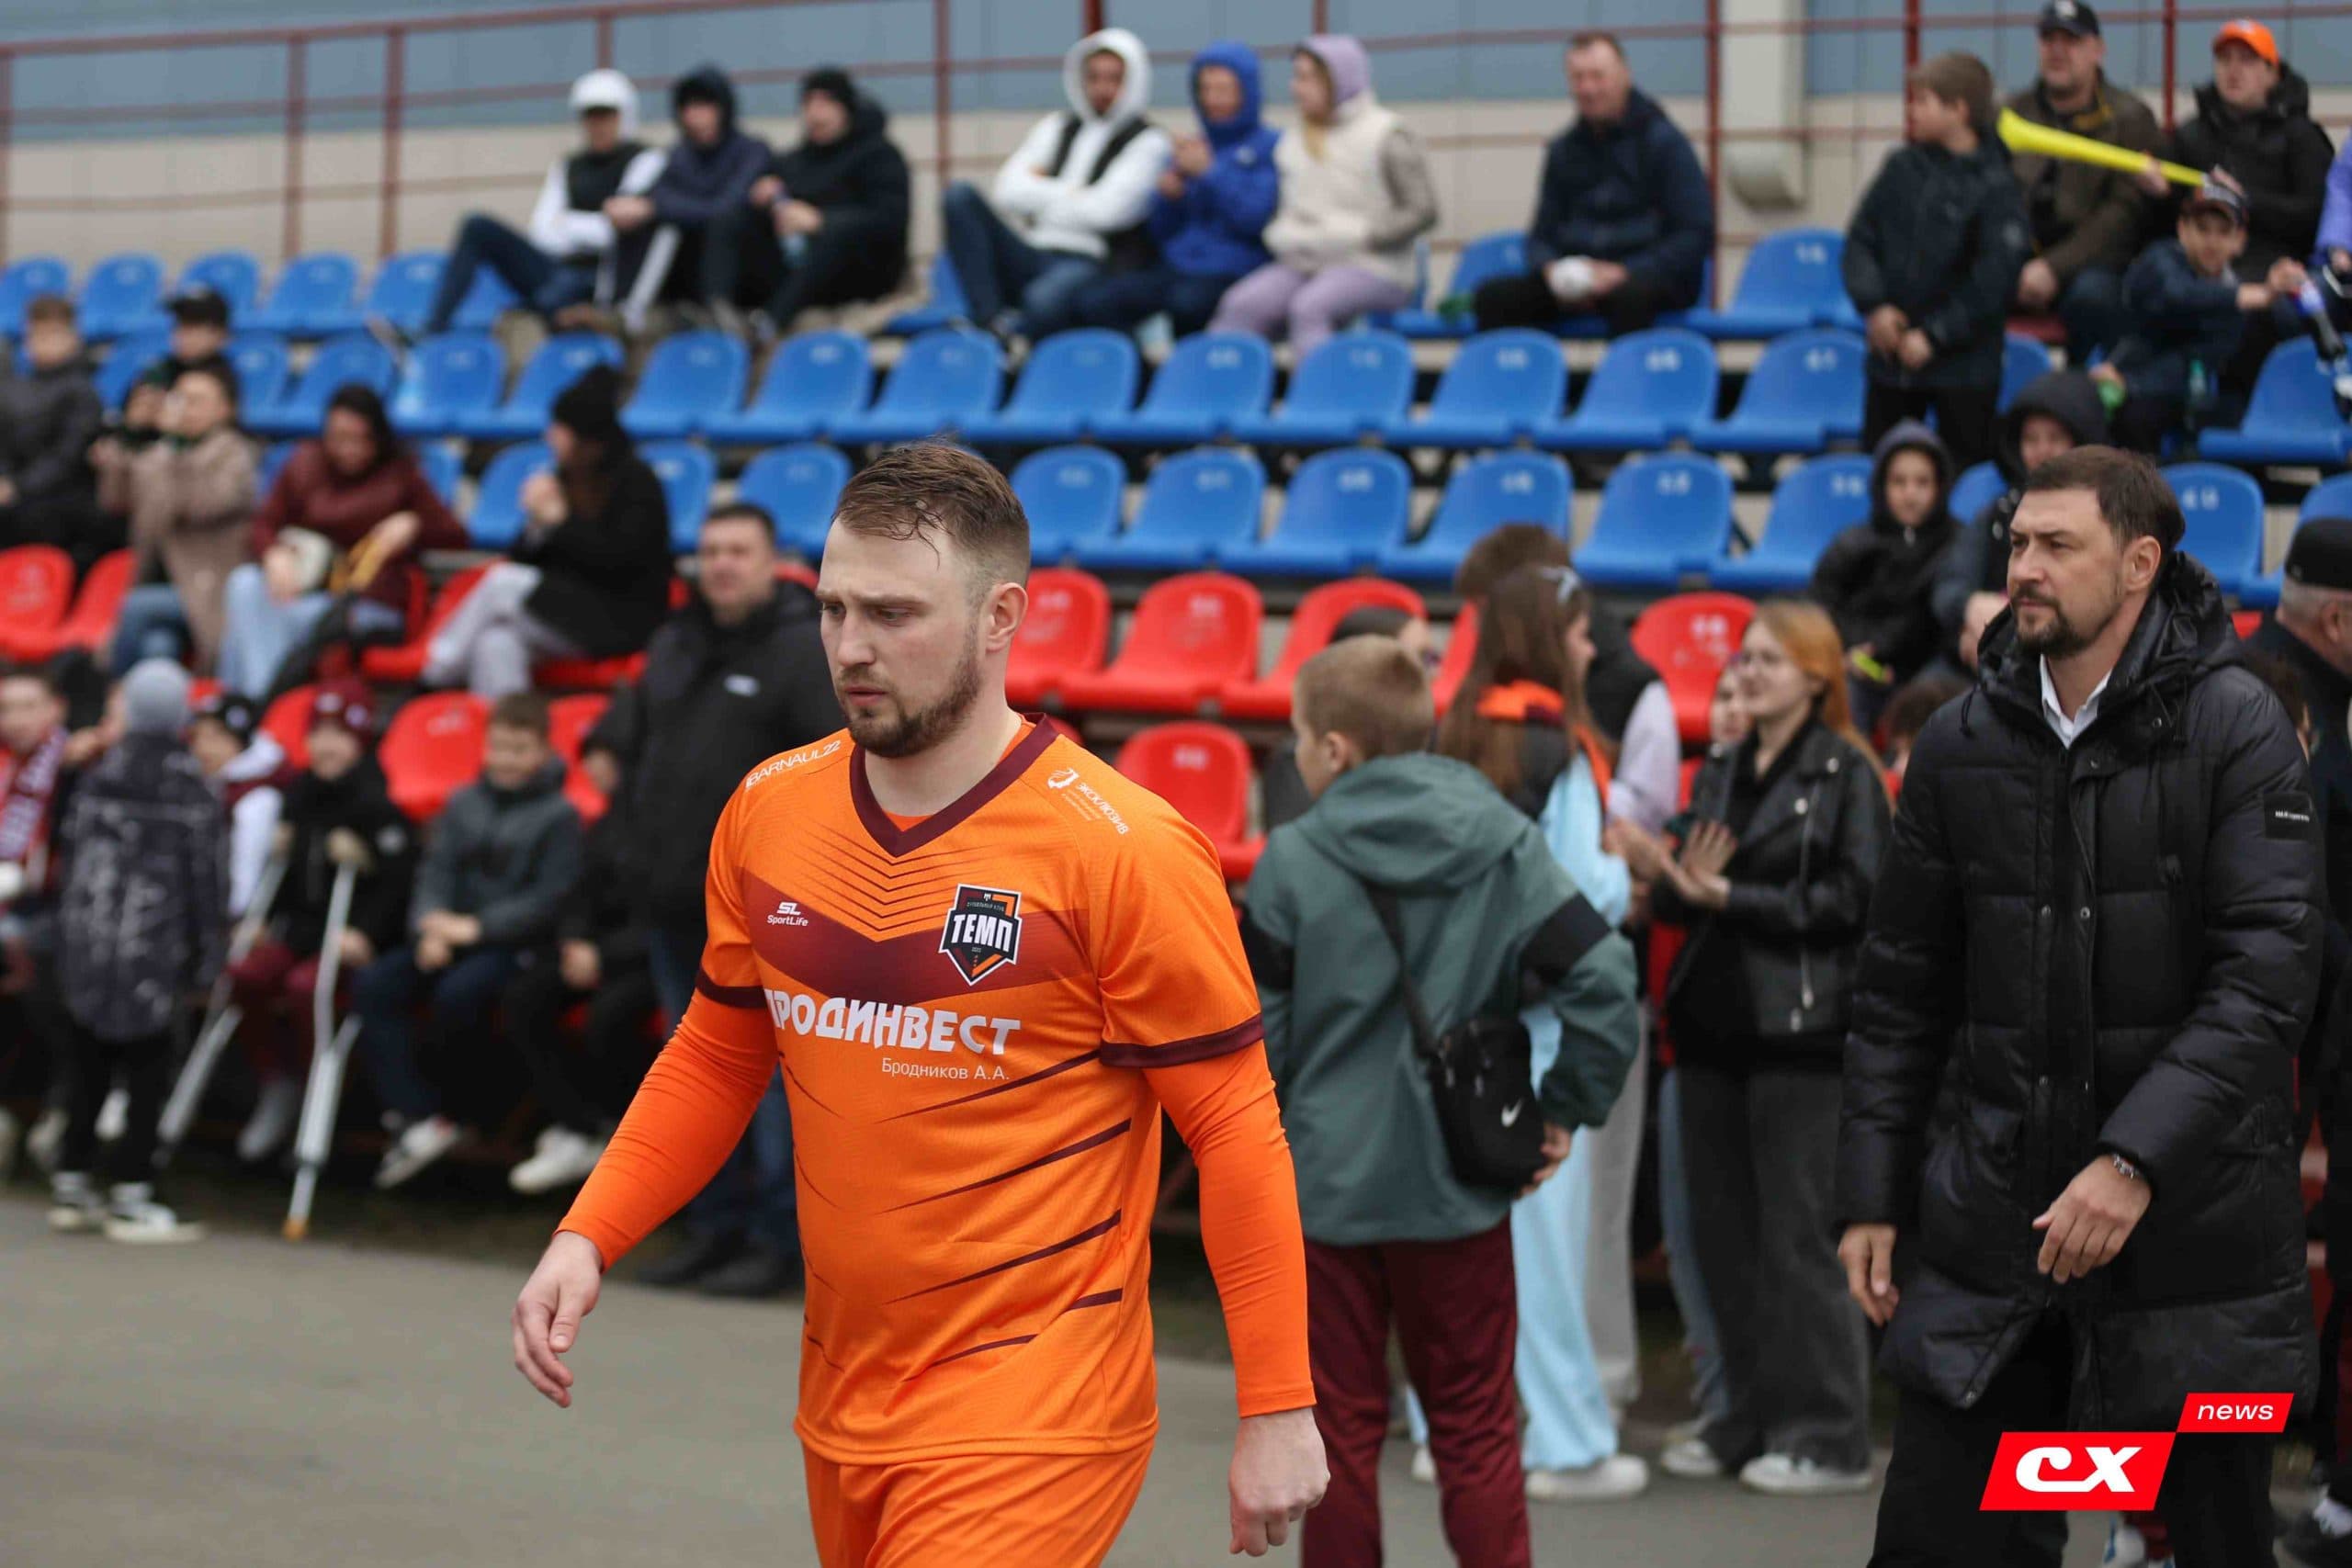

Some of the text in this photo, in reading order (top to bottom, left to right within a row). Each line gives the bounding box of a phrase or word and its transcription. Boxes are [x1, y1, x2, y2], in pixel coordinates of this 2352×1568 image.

[1076, 782, 1128, 835] ЭКСКЛЮЗИВ
[776, 901, 801, 915] SL
[767, 915, 808, 926] SportLife
[951, 914, 1012, 953] ТЕМП
[882, 1057, 968, 1079] Бродников
